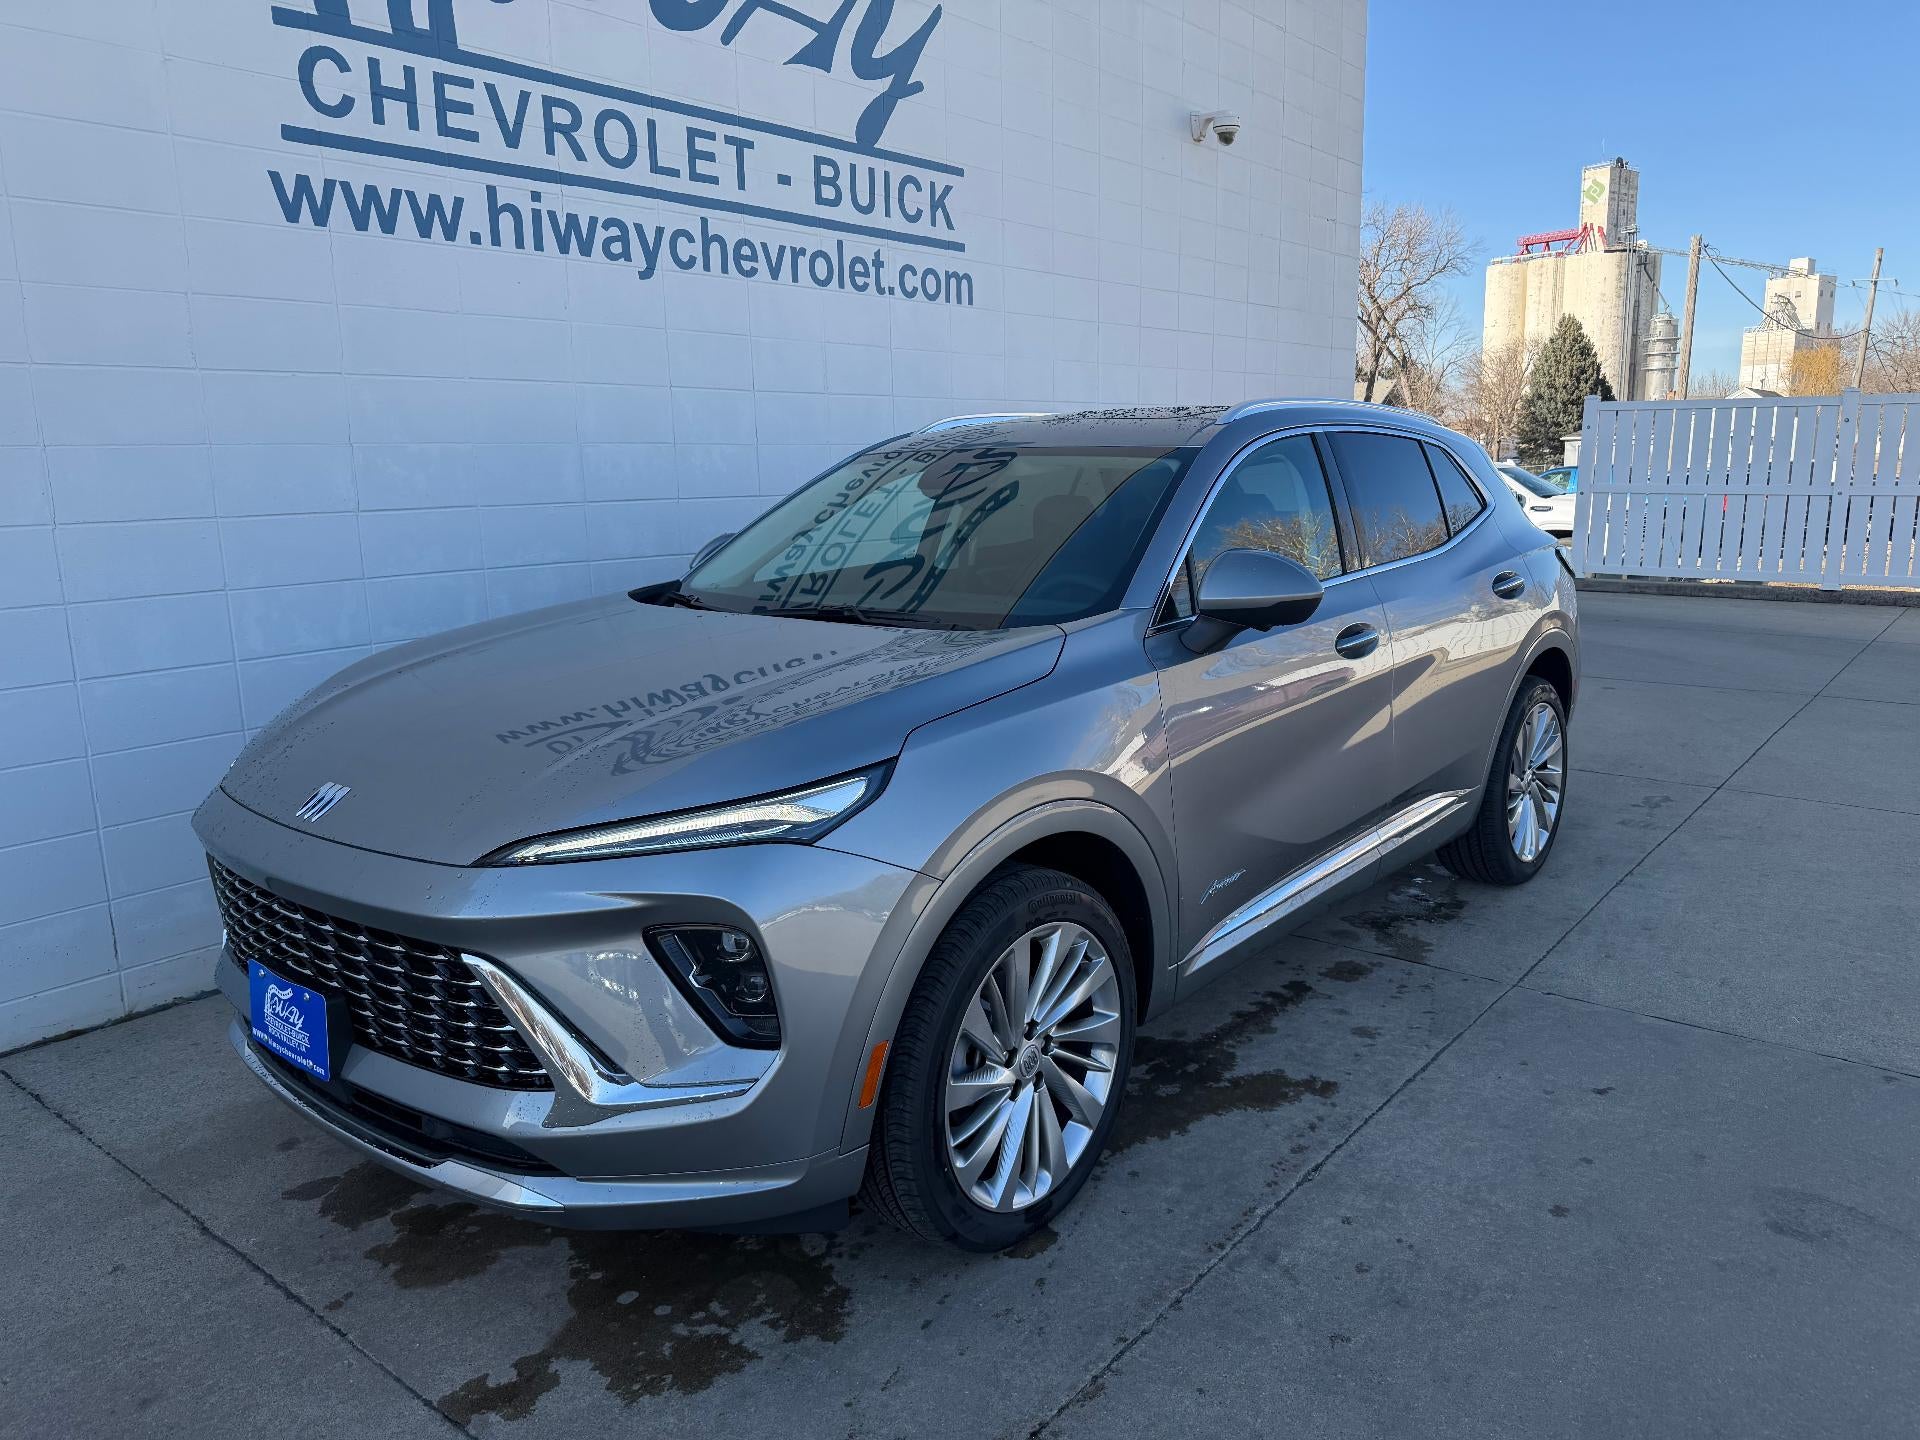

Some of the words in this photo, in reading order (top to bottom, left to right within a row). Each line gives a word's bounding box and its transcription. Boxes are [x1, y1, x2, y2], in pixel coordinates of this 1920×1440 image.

[298, 45, 754, 191] CHEVROLET
[814, 155, 955, 231] BUICK
[267, 170, 974, 306] www.hiwaychevrolet.com
